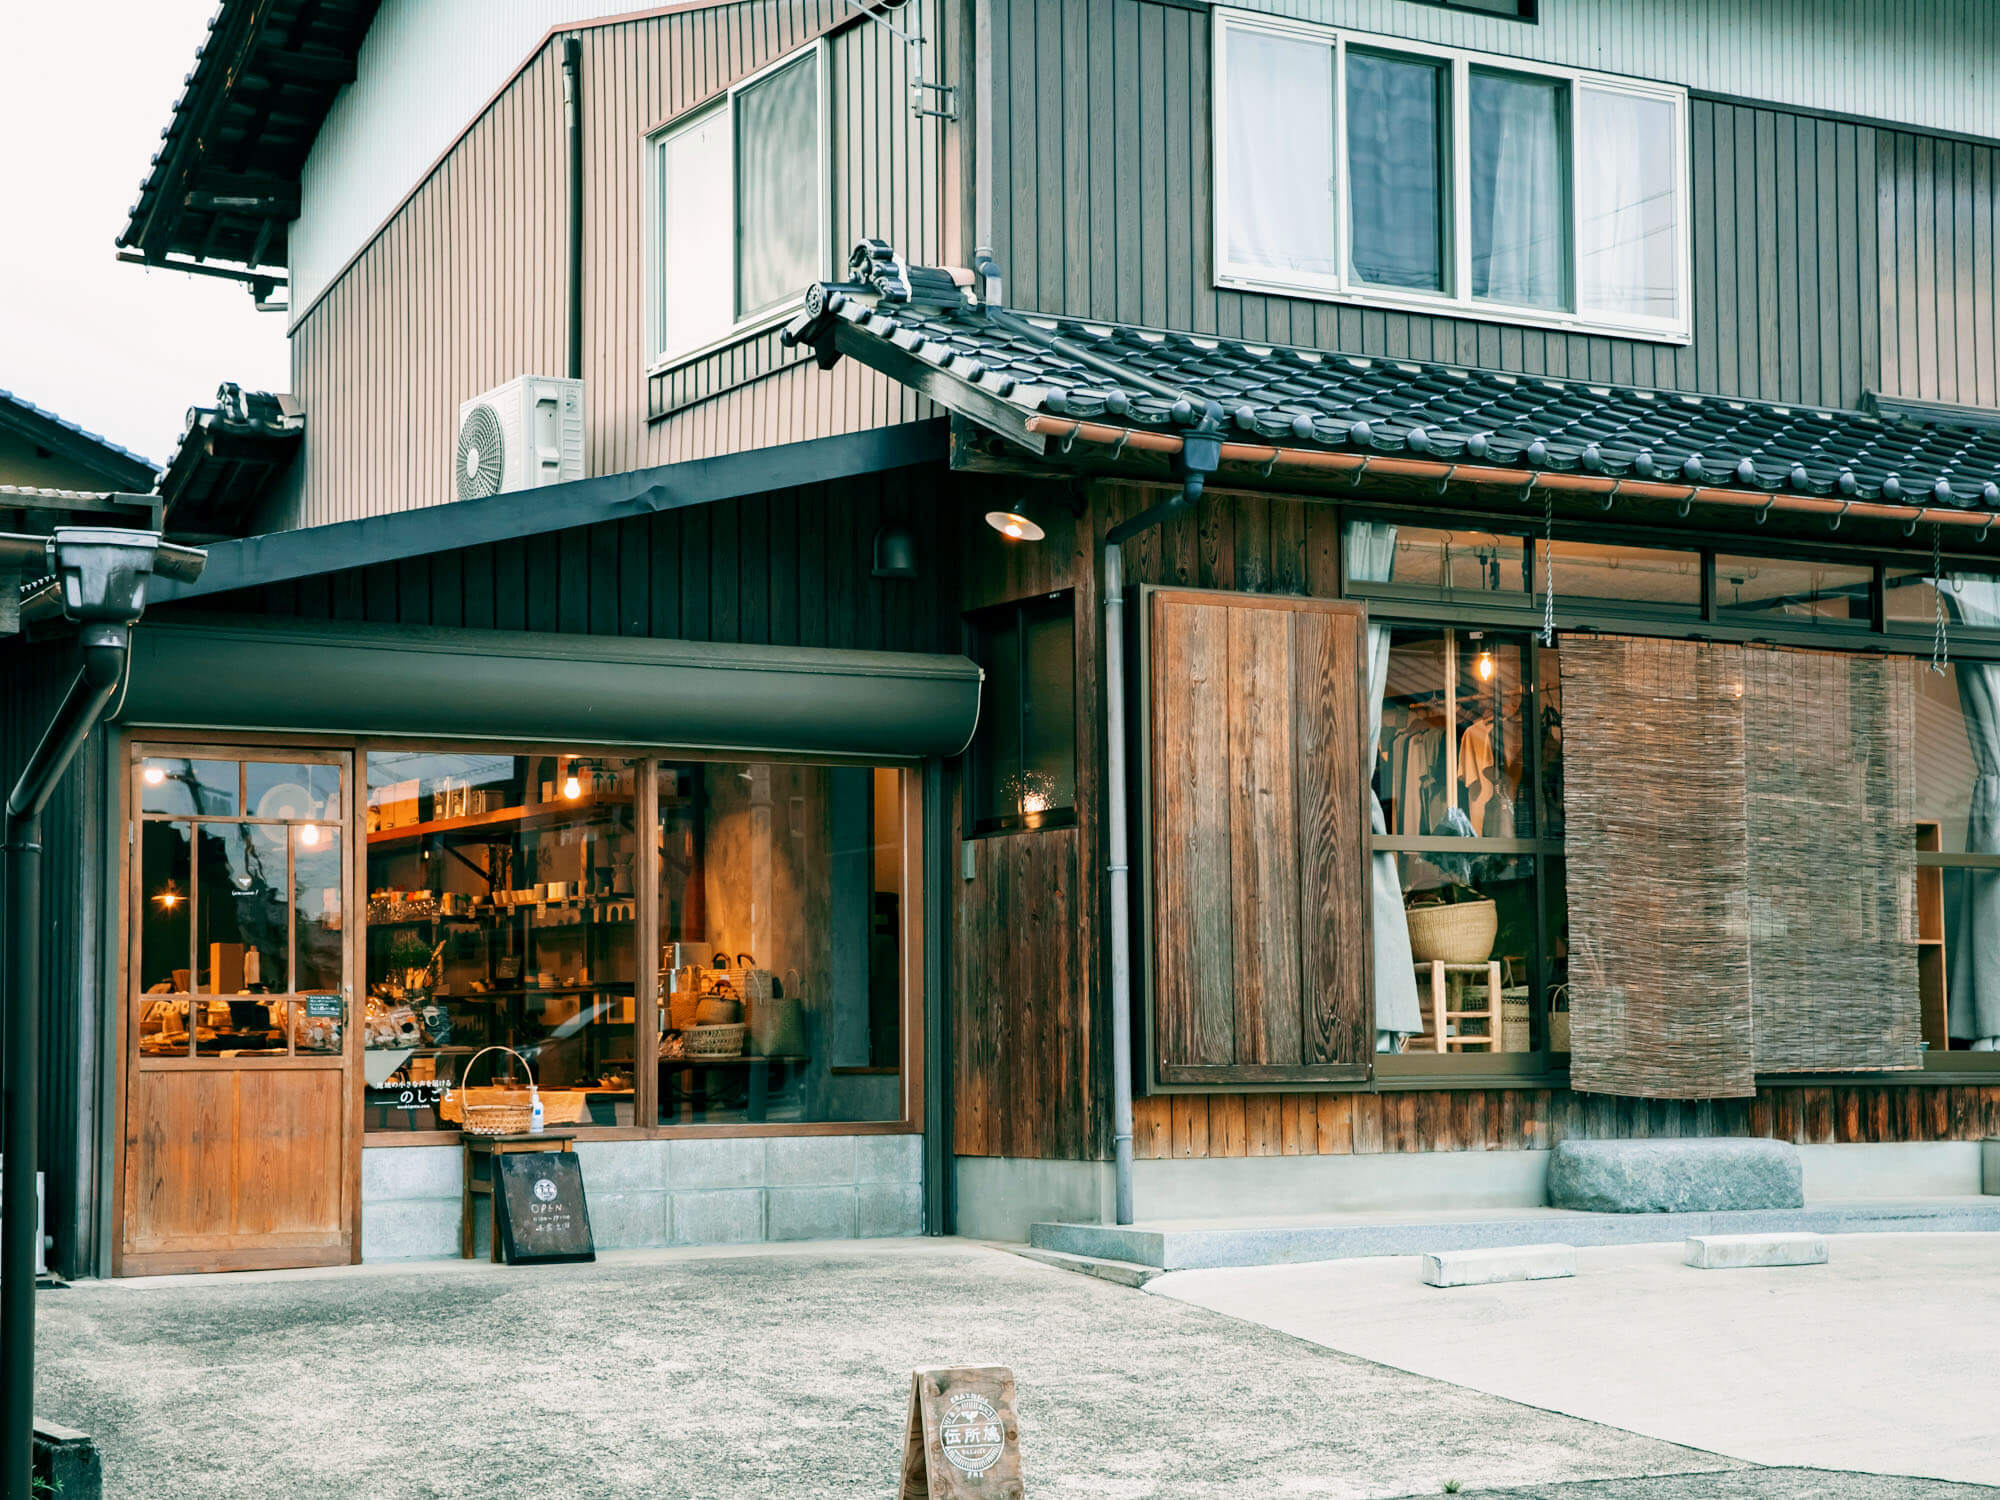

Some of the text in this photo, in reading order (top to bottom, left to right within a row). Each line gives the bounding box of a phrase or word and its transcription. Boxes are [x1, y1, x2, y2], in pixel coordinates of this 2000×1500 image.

[400, 1088, 455, 1104] のしごと
[531, 1203, 562, 1214] OPEN
